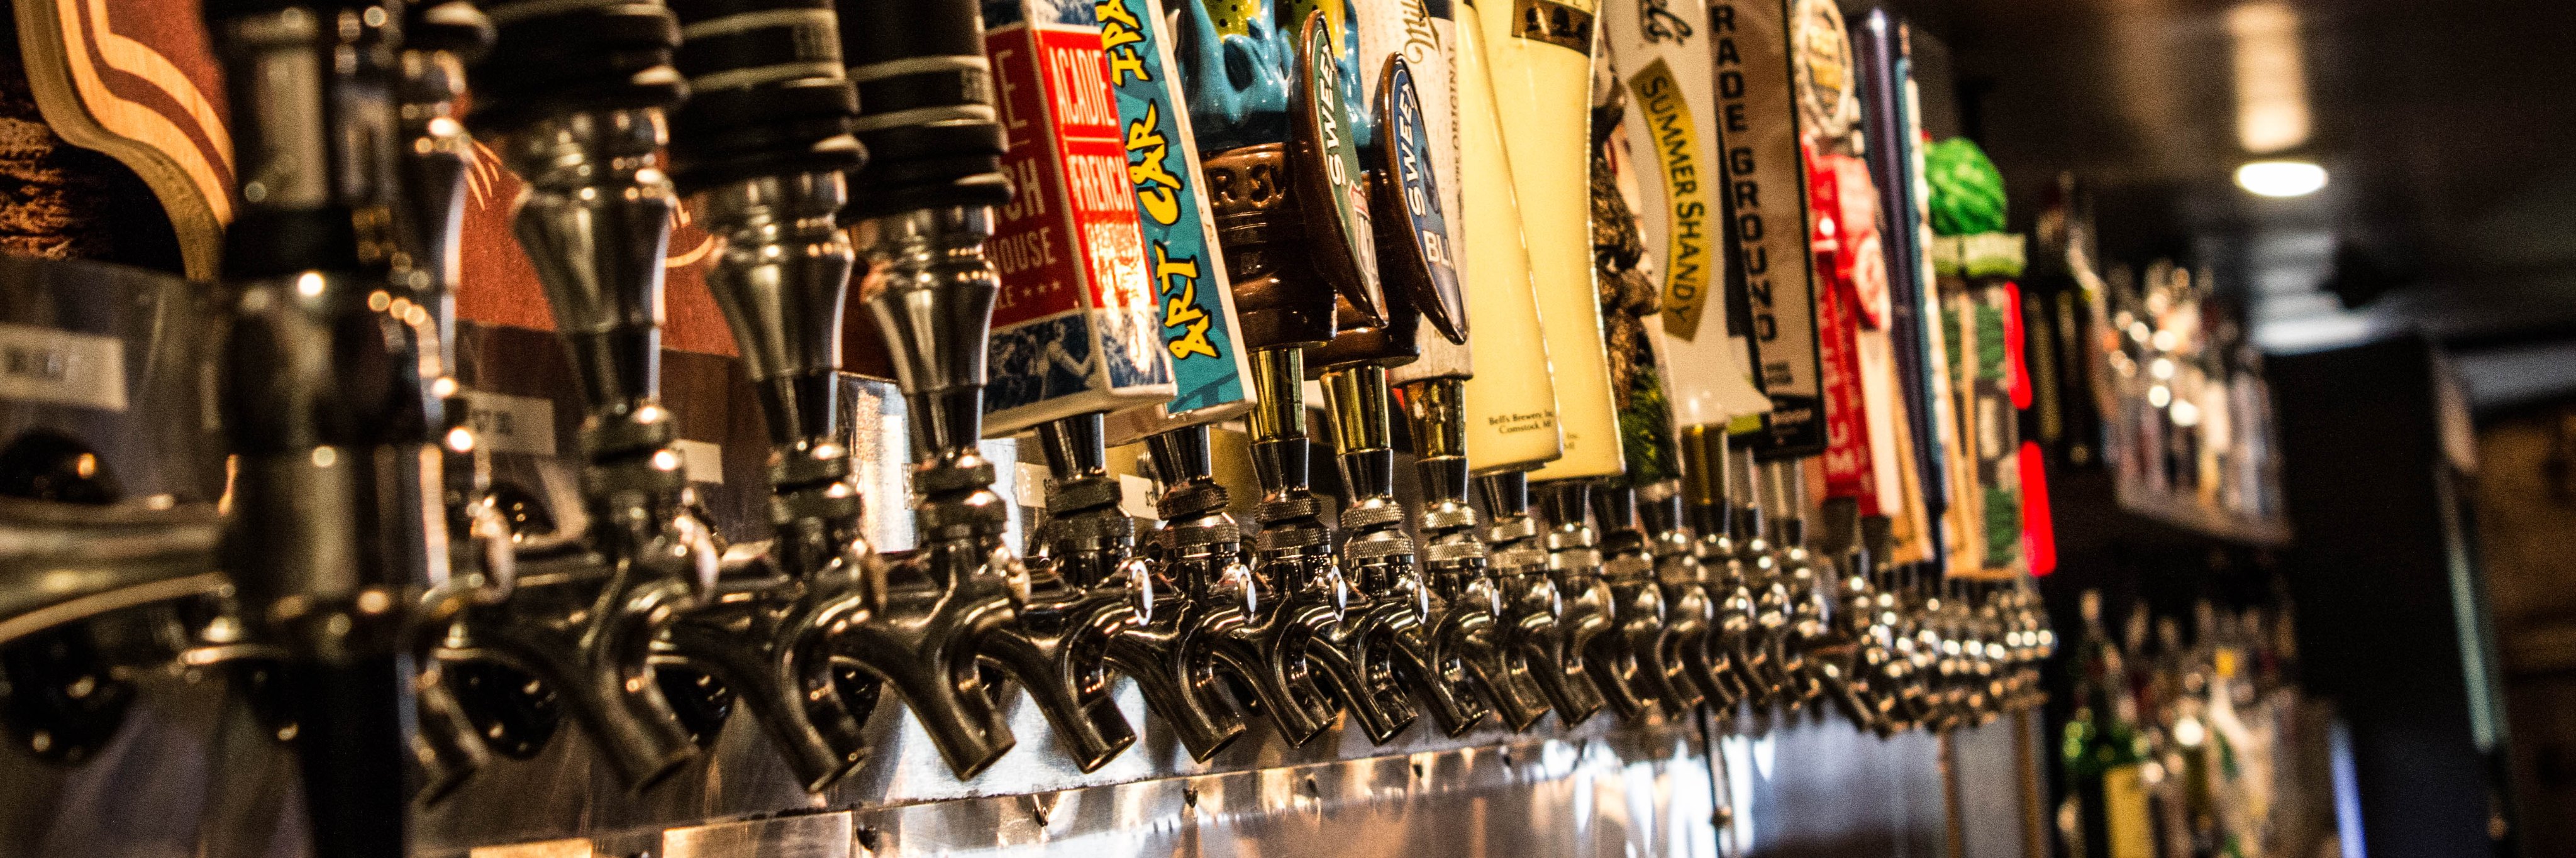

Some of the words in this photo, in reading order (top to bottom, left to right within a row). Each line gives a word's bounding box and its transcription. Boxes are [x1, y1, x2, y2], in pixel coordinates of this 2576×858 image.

[1095, 0, 1152, 87] IPA
[1400, 0, 1436, 64] Mil
[1049, 47, 1116, 126] ACADIE
[1125, 98, 1184, 226] CAR
[1641, 75, 1697, 197] SUMMER
[1711, 5, 1748, 131] RADE
[1731, 148, 1777, 342] GROUND
[1067, 155, 1135, 211] FRENCH
[1422, 230, 1451, 267] BL
[1668, 201, 1705, 322] SHANDY
[1153, 239, 1222, 360] ART
[1489, 415, 1510, 426] Bell's
